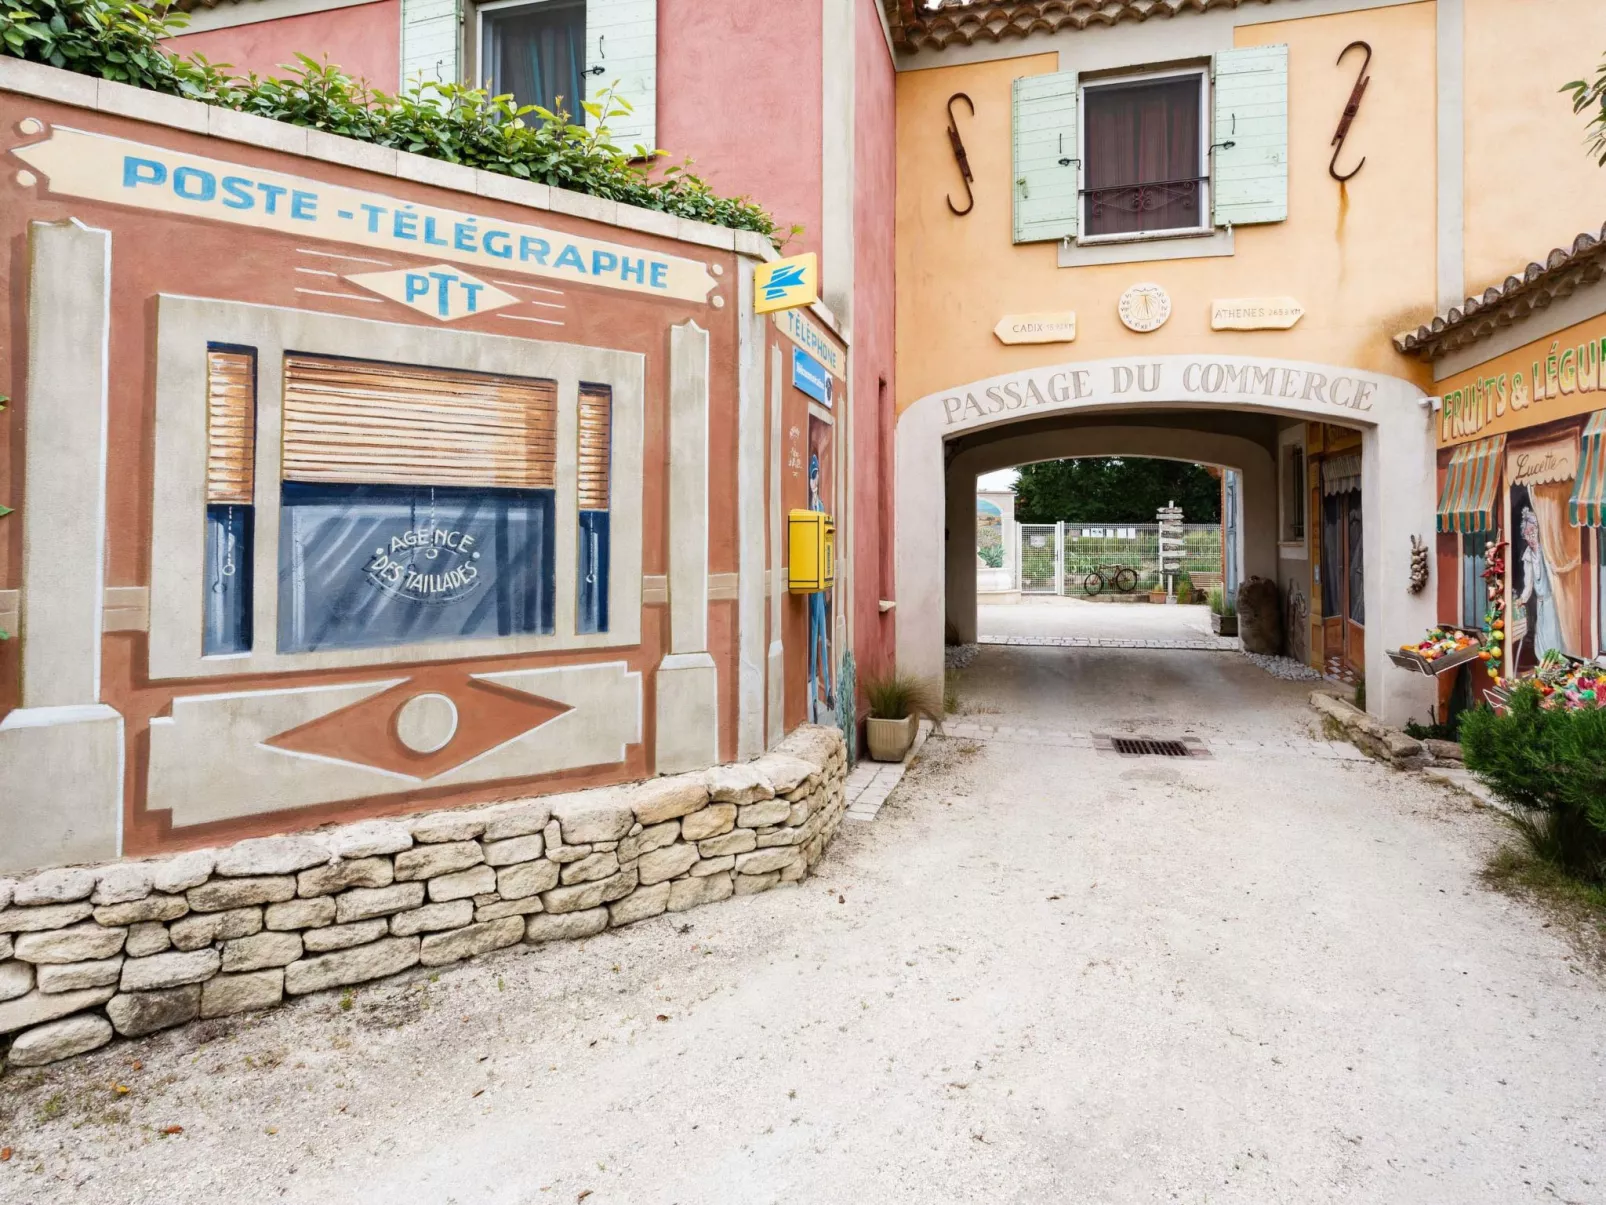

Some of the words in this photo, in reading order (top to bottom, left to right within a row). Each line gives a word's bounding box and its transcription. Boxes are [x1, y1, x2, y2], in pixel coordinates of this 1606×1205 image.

[123, 156, 318, 221] POSTE
[405, 271, 484, 316] PTT
[1012, 323, 1043, 333] CADIX
[1214, 307, 1265, 320] ATHENES
[787, 311, 837, 369] TÉLÉPHONE
[942, 368, 1093, 425] PASSAGE
[1111, 362, 1165, 394] DU
[1182, 362, 1378, 412] COMMERCE
[1510, 372, 1529, 411] &
[1515, 450, 1564, 480] Lucette
[391, 529, 475, 553] AGENCE
[371, 555, 405, 582] DES
[405, 560, 478, 593] TAILLADES
